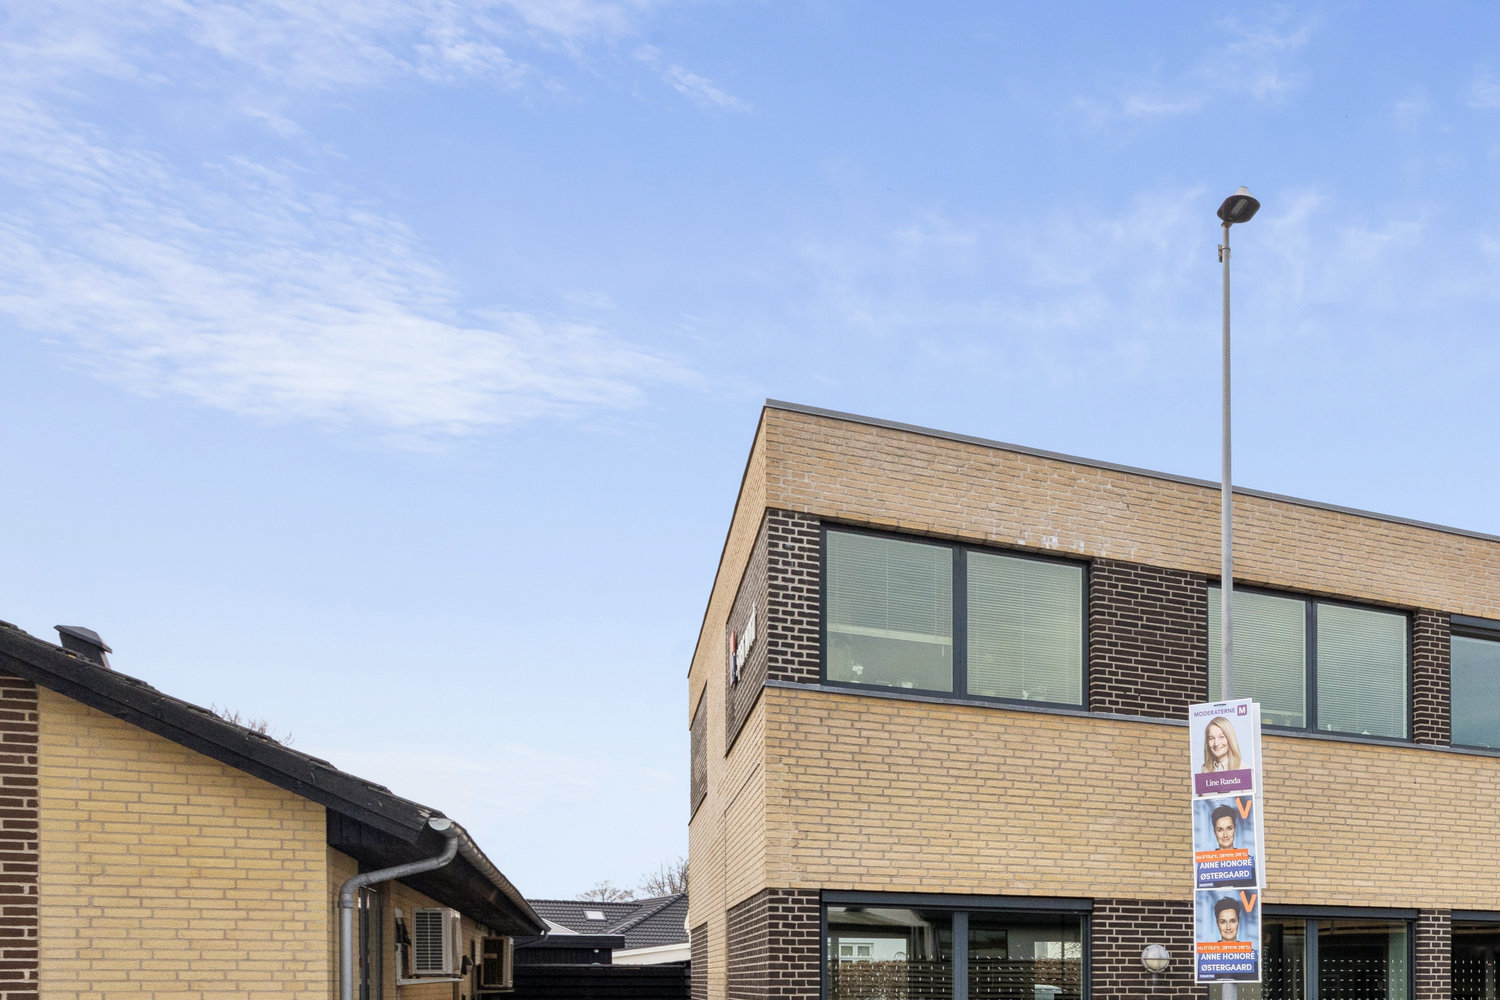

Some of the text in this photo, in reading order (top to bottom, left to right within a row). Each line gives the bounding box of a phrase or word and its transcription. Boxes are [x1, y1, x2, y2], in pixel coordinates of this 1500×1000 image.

[1194, 707, 1236, 717] MODERATERNE
[1205, 776, 1241, 787] Line Randa
[1235, 797, 1252, 819] V
[1200, 857, 1253, 869] ANNE HONORÉ
[1200, 870, 1250, 880] ØSTERGAARD
[1240, 890, 1257, 912] V
[1222, 950, 1255, 960] HONORÉ
[1201, 963, 1252, 971] ØSTERGAARD
